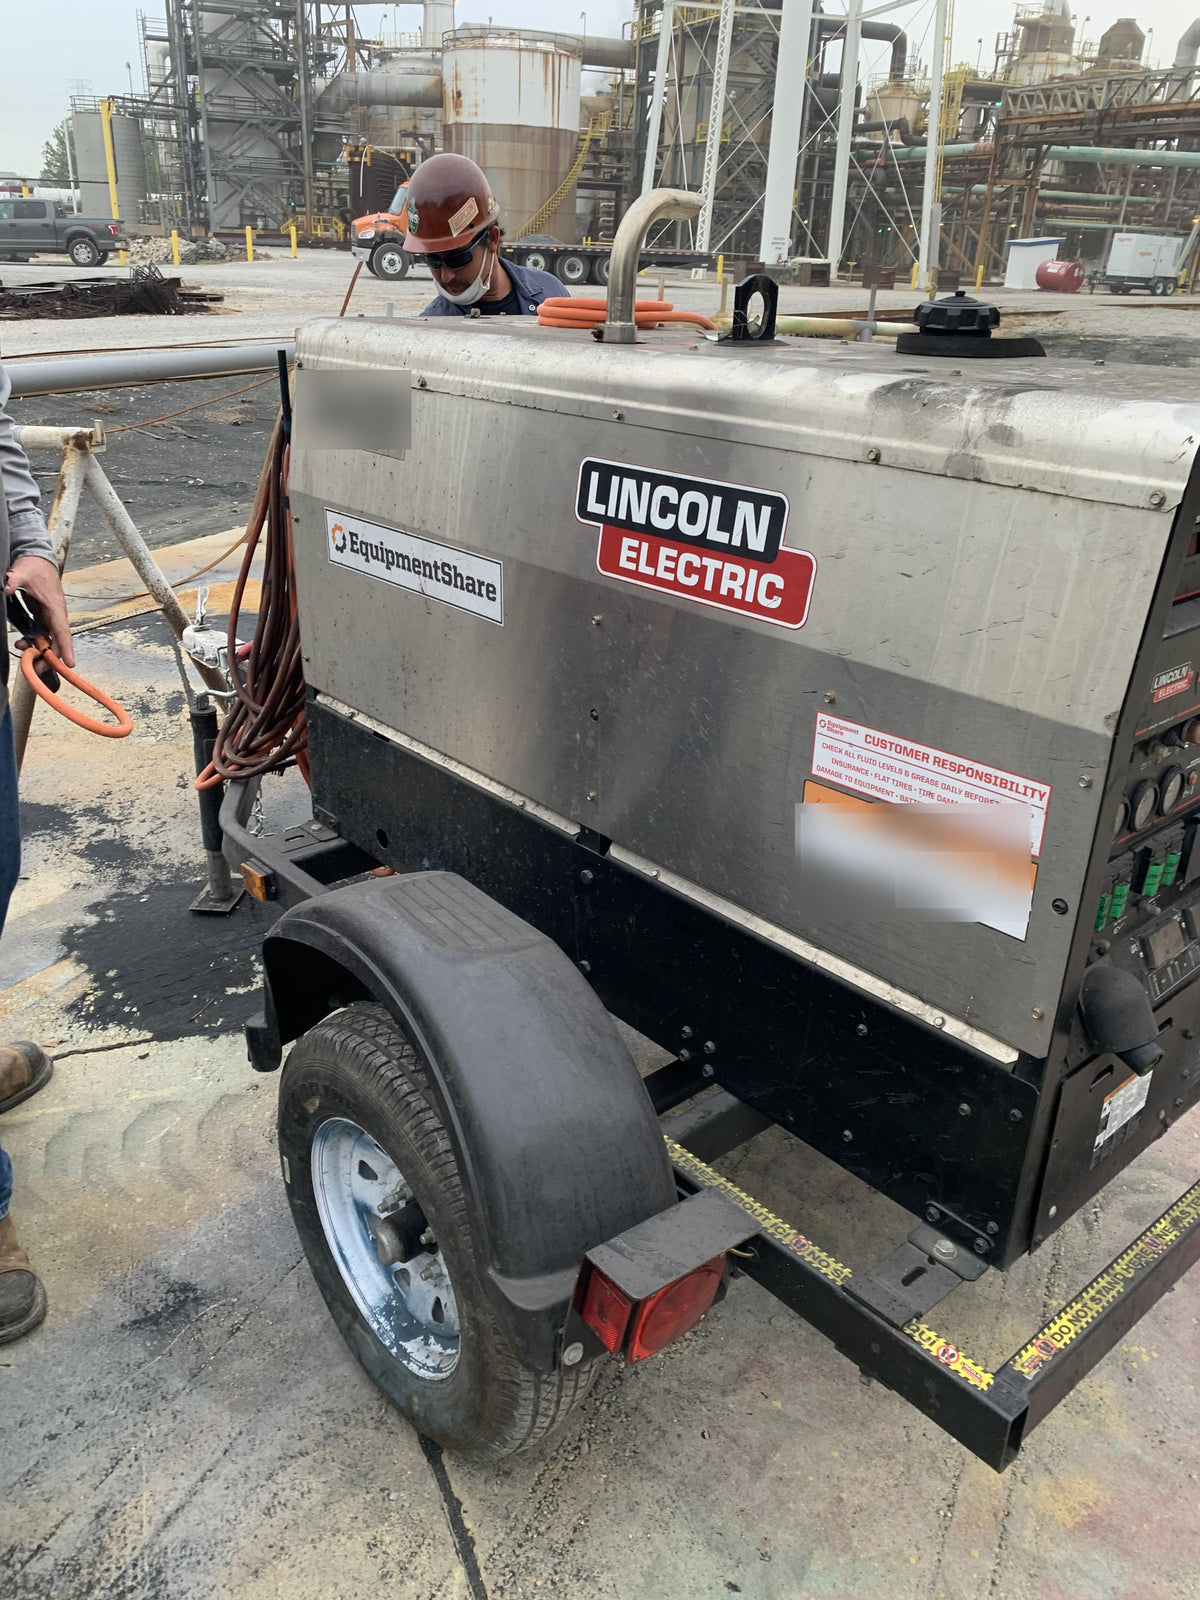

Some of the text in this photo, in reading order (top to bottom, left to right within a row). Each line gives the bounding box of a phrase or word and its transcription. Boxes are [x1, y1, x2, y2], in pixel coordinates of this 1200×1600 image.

[586, 470, 772, 552] LINCOLN
[348, 530, 497, 602] EquipmentShare
[618, 536, 785, 609] ELECTRIC
[1153, 665, 1189, 689] LINCOLN
[1158, 679, 1189, 698] ELECTRIC
[826, 726, 844, 736] Share
[827, 719, 859, 735] Equipment
[816, 764, 844, 780] DAMAGE
[844, 774, 853, 783] TO
[854, 778, 895, 798] EQUIPMENT
[821, 742, 843, 754] CHECK
[844, 750, 856, 759] ALL
[857, 754, 877, 766] FLUID
[878, 760, 903, 775] LEVELS
[911, 772, 939, 788] GREASE
[940, 782, 963, 796] DAILY
[831, 757, 869, 776] INSURANCE
[874, 773, 890, 783] FLAT
[891, 778, 913, 792] TIRES
[918, 788, 935, 800] TIRE
[864, 733, 1047, 802] CUSTOMER RESPONSIBILITY
[677, 1153, 719, 1184] TENEZ
[716, 1182, 773, 1223] DEBOUT
[769, 1222, 791, 1238] ICI
[1159, 1225, 1174, 1240] NE
[806, 1250, 831, 1269] NO
[1050, 1324, 1071, 1344] DO
[1068, 1303, 1093, 1327] NOT
[1088, 1270, 1124, 1306] STAND
